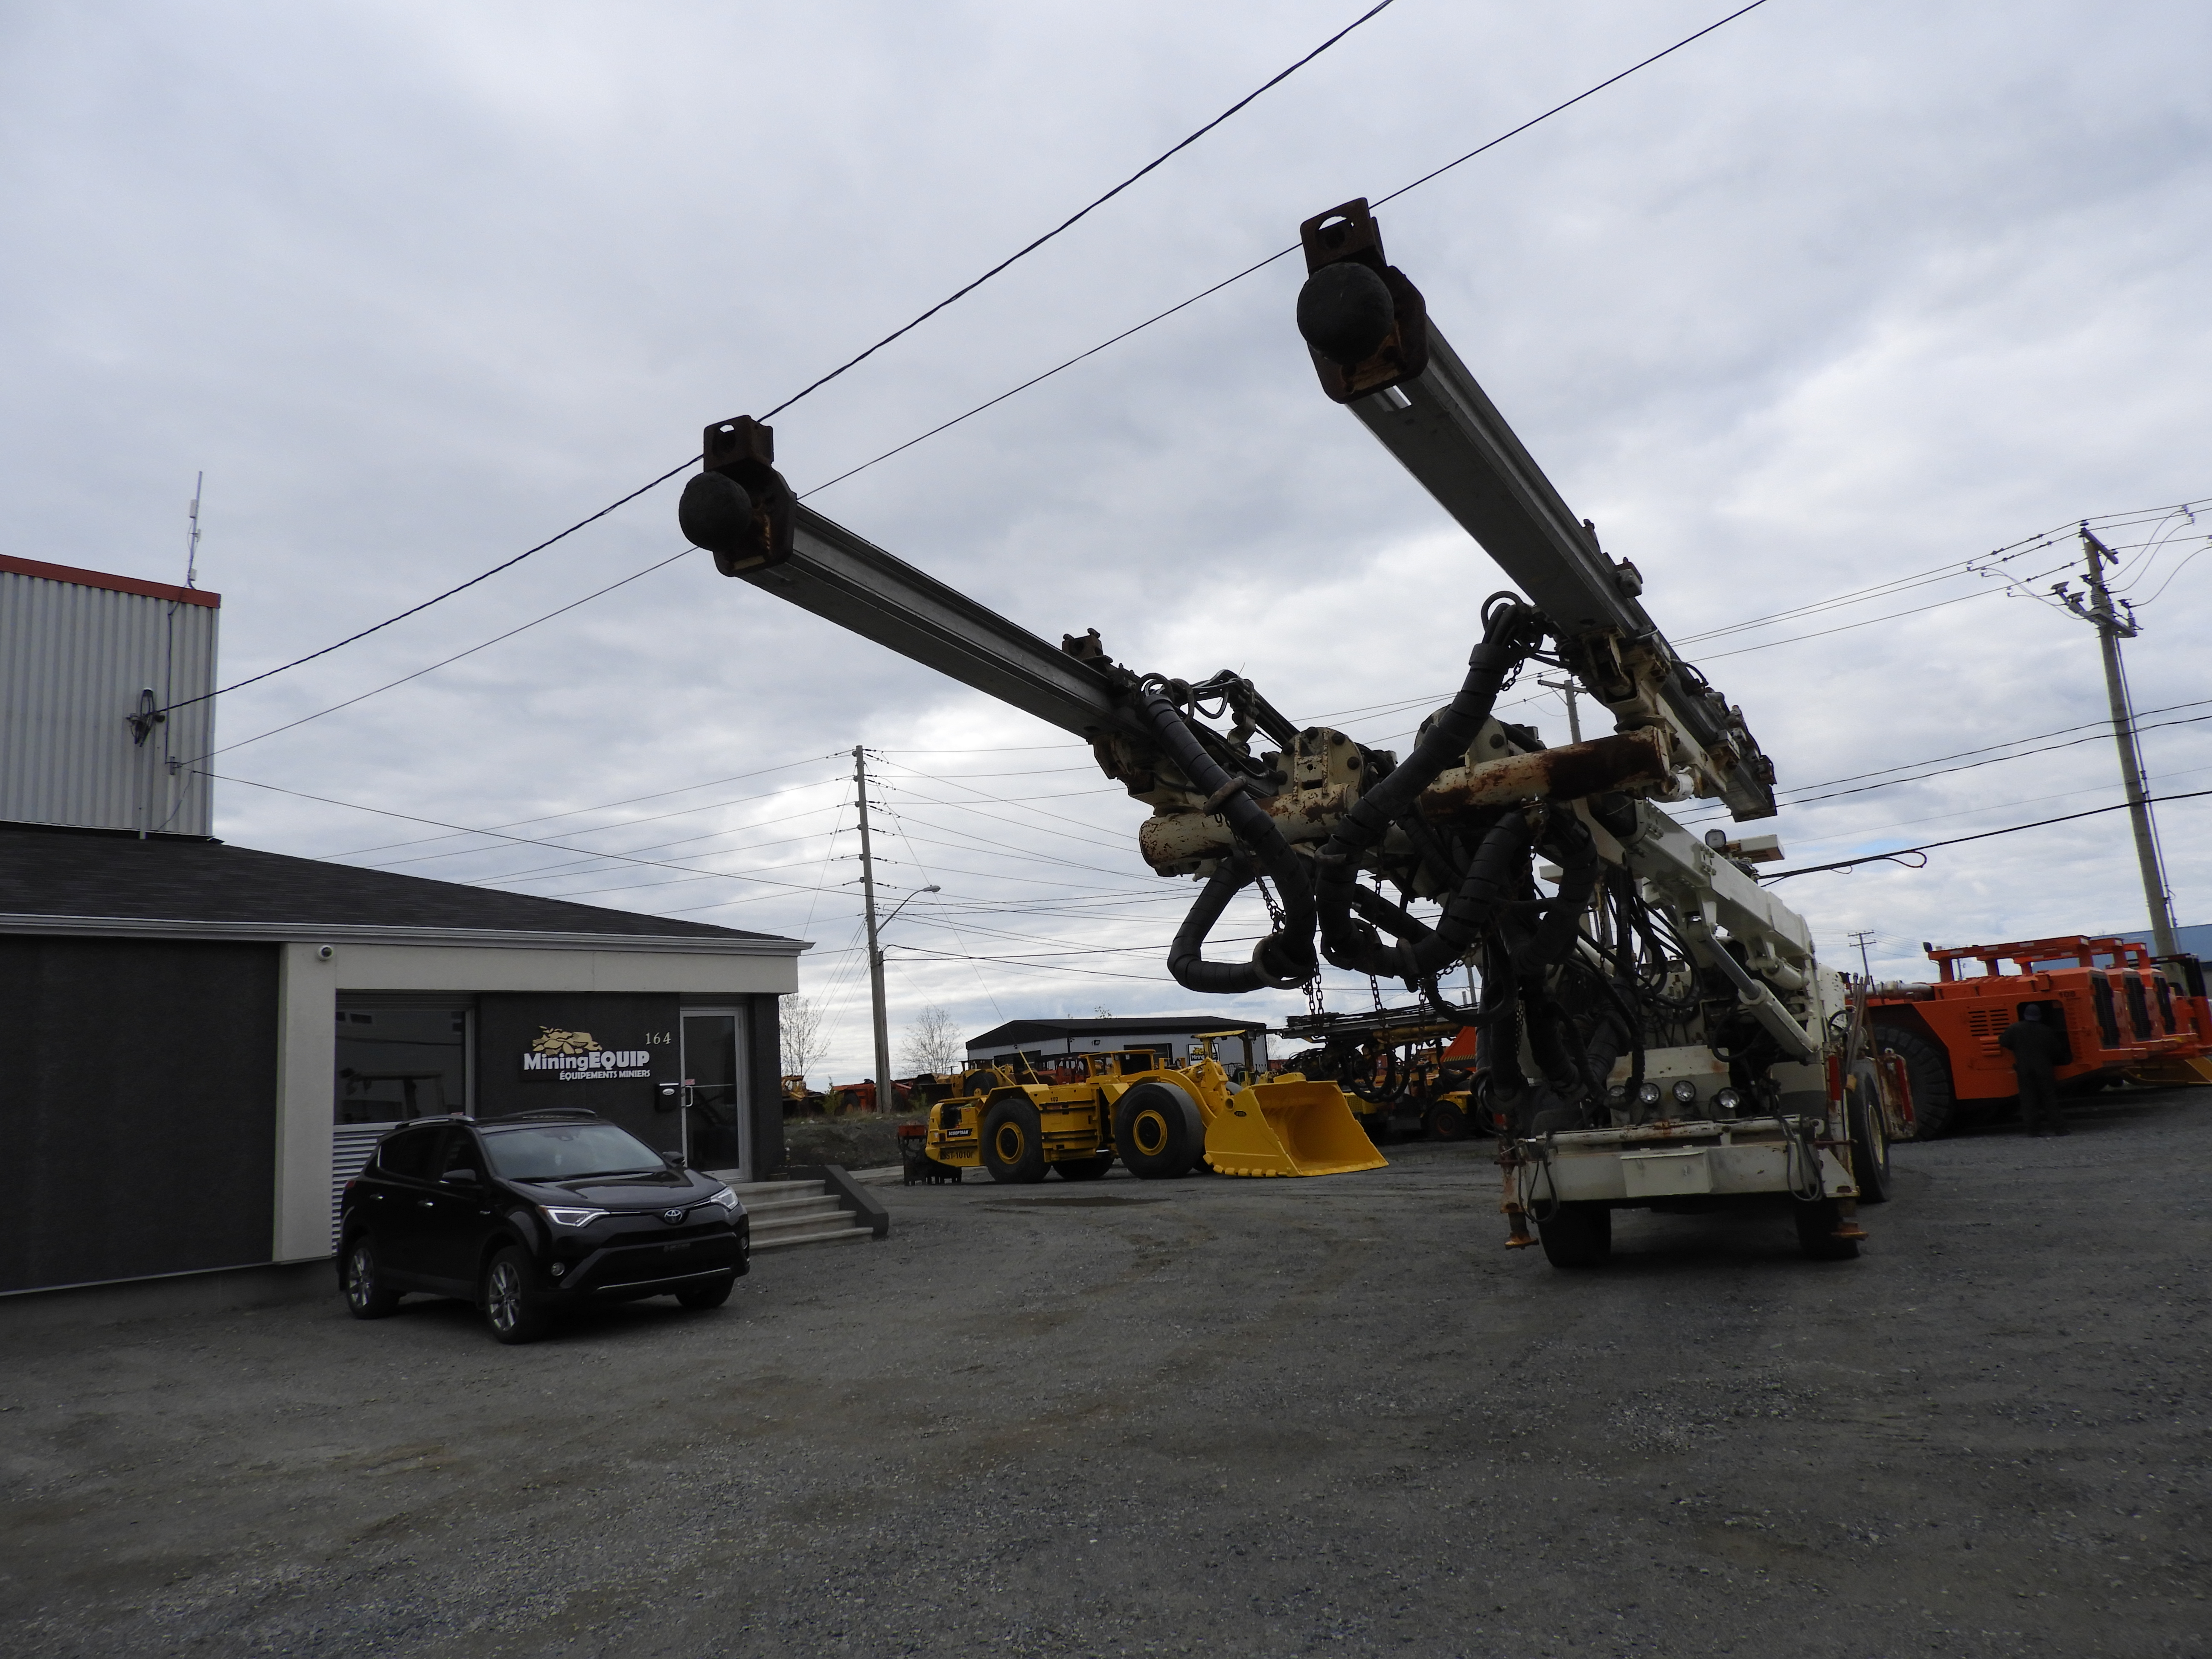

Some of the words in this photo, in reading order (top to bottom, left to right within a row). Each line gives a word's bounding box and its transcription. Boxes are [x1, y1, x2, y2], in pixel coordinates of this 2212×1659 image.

[645, 1032, 671, 1045] 164
[524, 1051, 650, 1071] MiningEQUIP
[559, 1071, 617, 1081] ÉQUIPEMENTS
[619, 1069, 650, 1078] MINIERS
